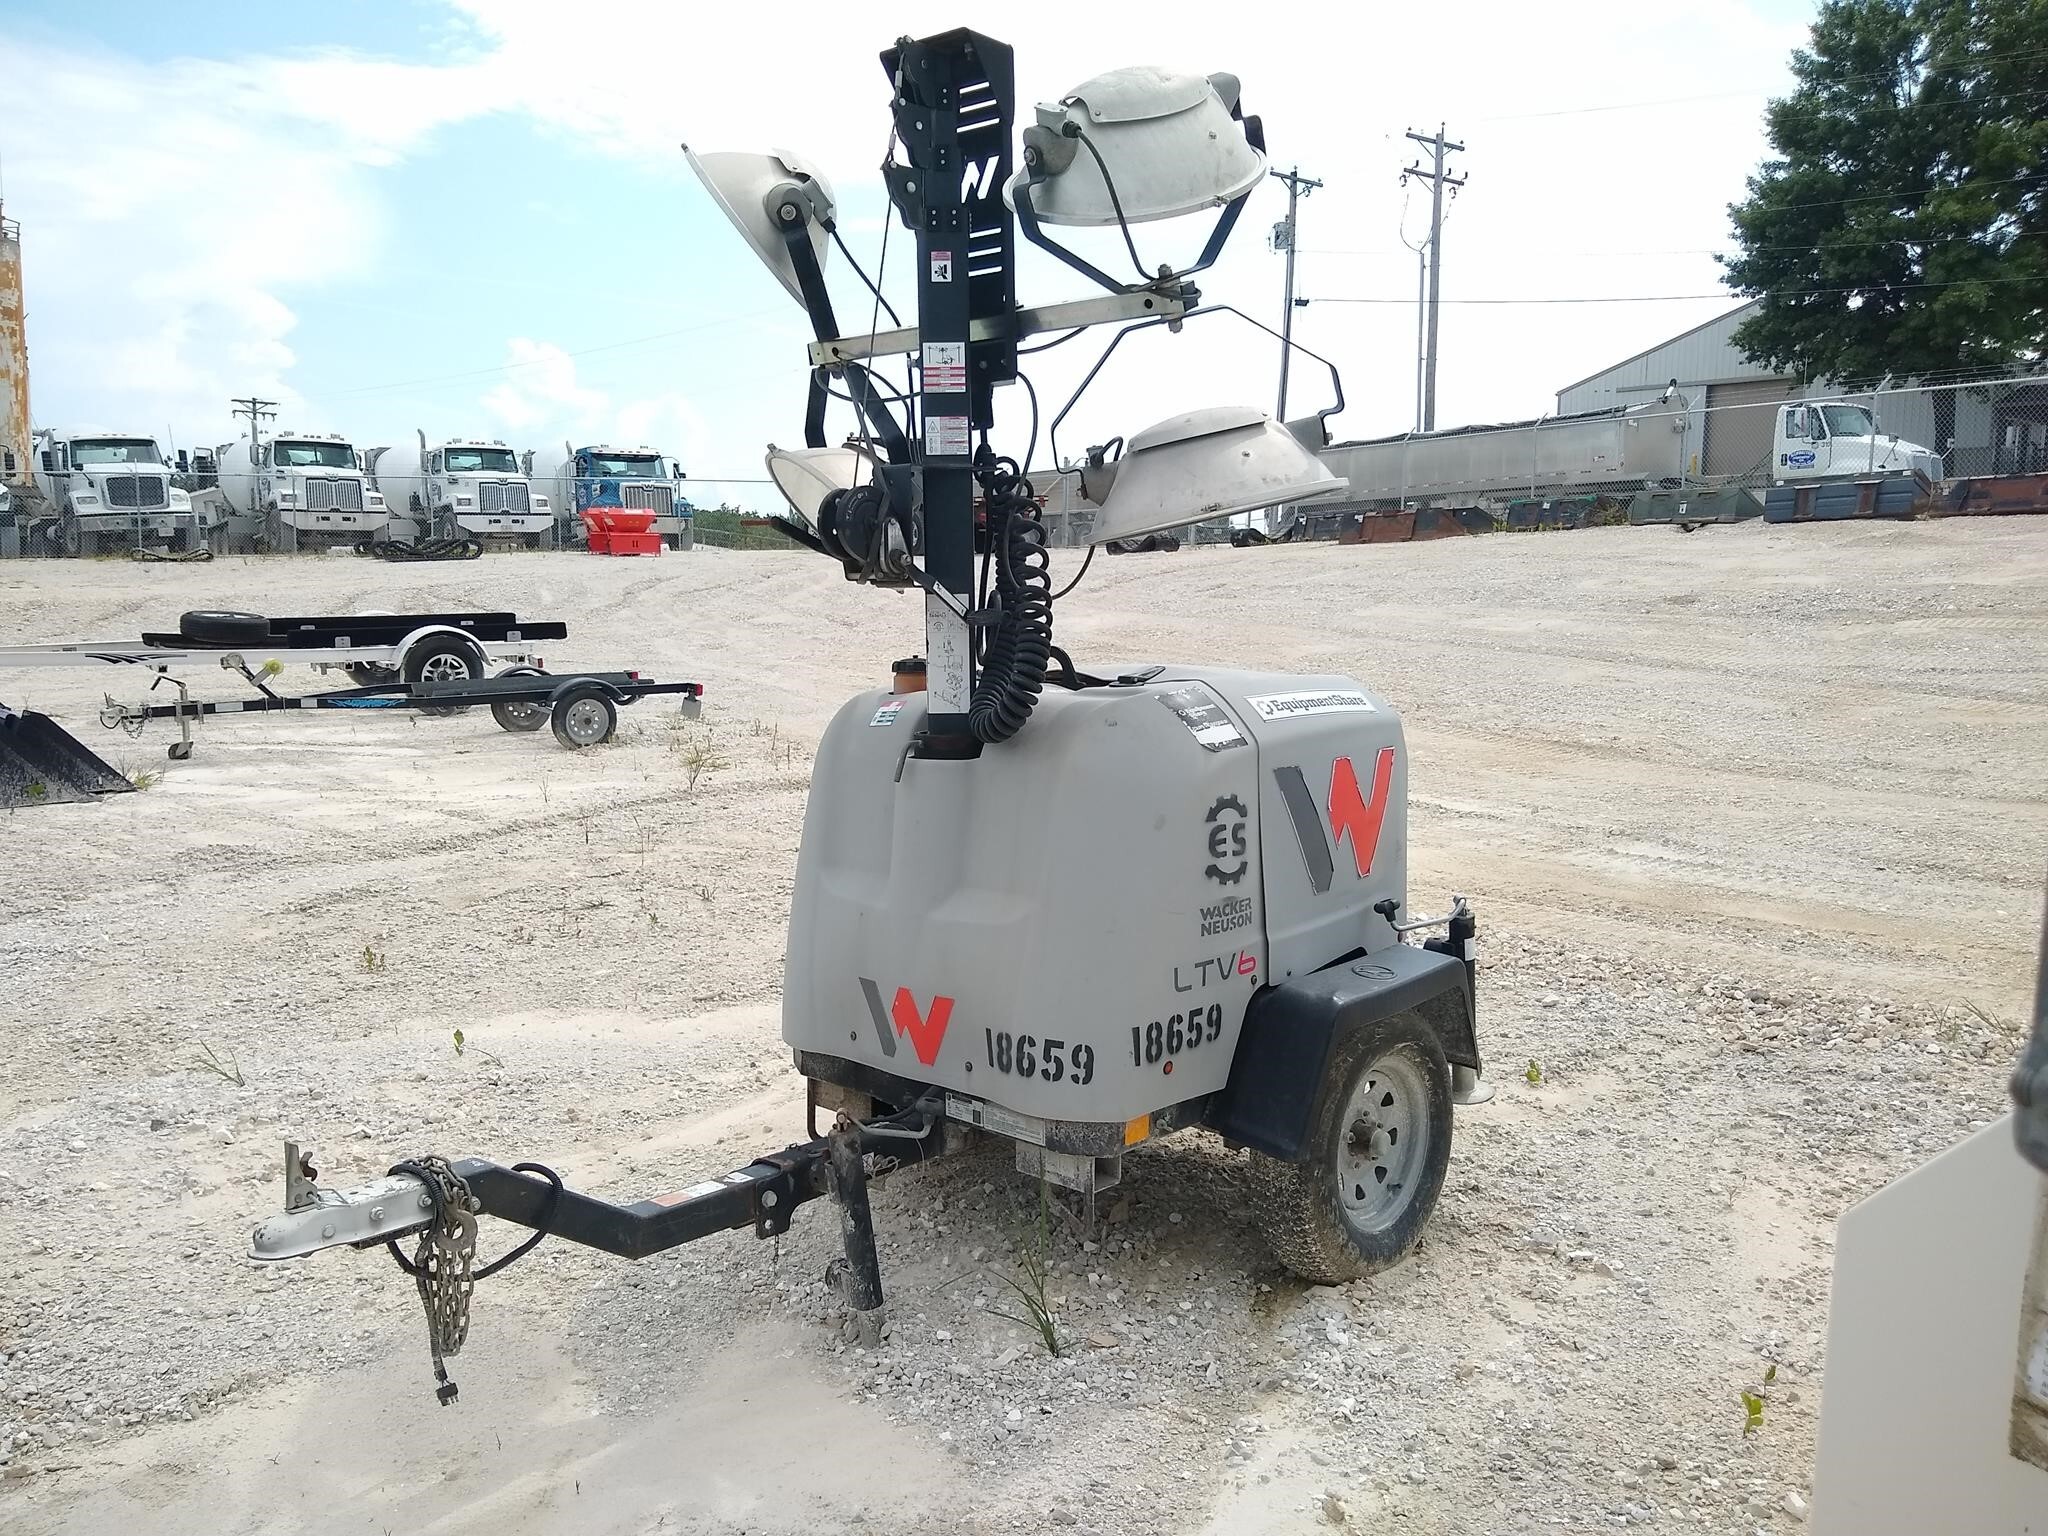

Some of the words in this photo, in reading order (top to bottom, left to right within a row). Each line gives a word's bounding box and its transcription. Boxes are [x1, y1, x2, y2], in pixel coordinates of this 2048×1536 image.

[1274, 694, 1367, 712] EquipmentShare
[1200, 897, 1252, 922] WACKER
[1201, 911, 1252, 937] NEUSON
[1173, 950, 1256, 993] LTV6
[1132, 1003, 1222, 1067] 18659
[985, 1027, 1095, 1086] 18659
